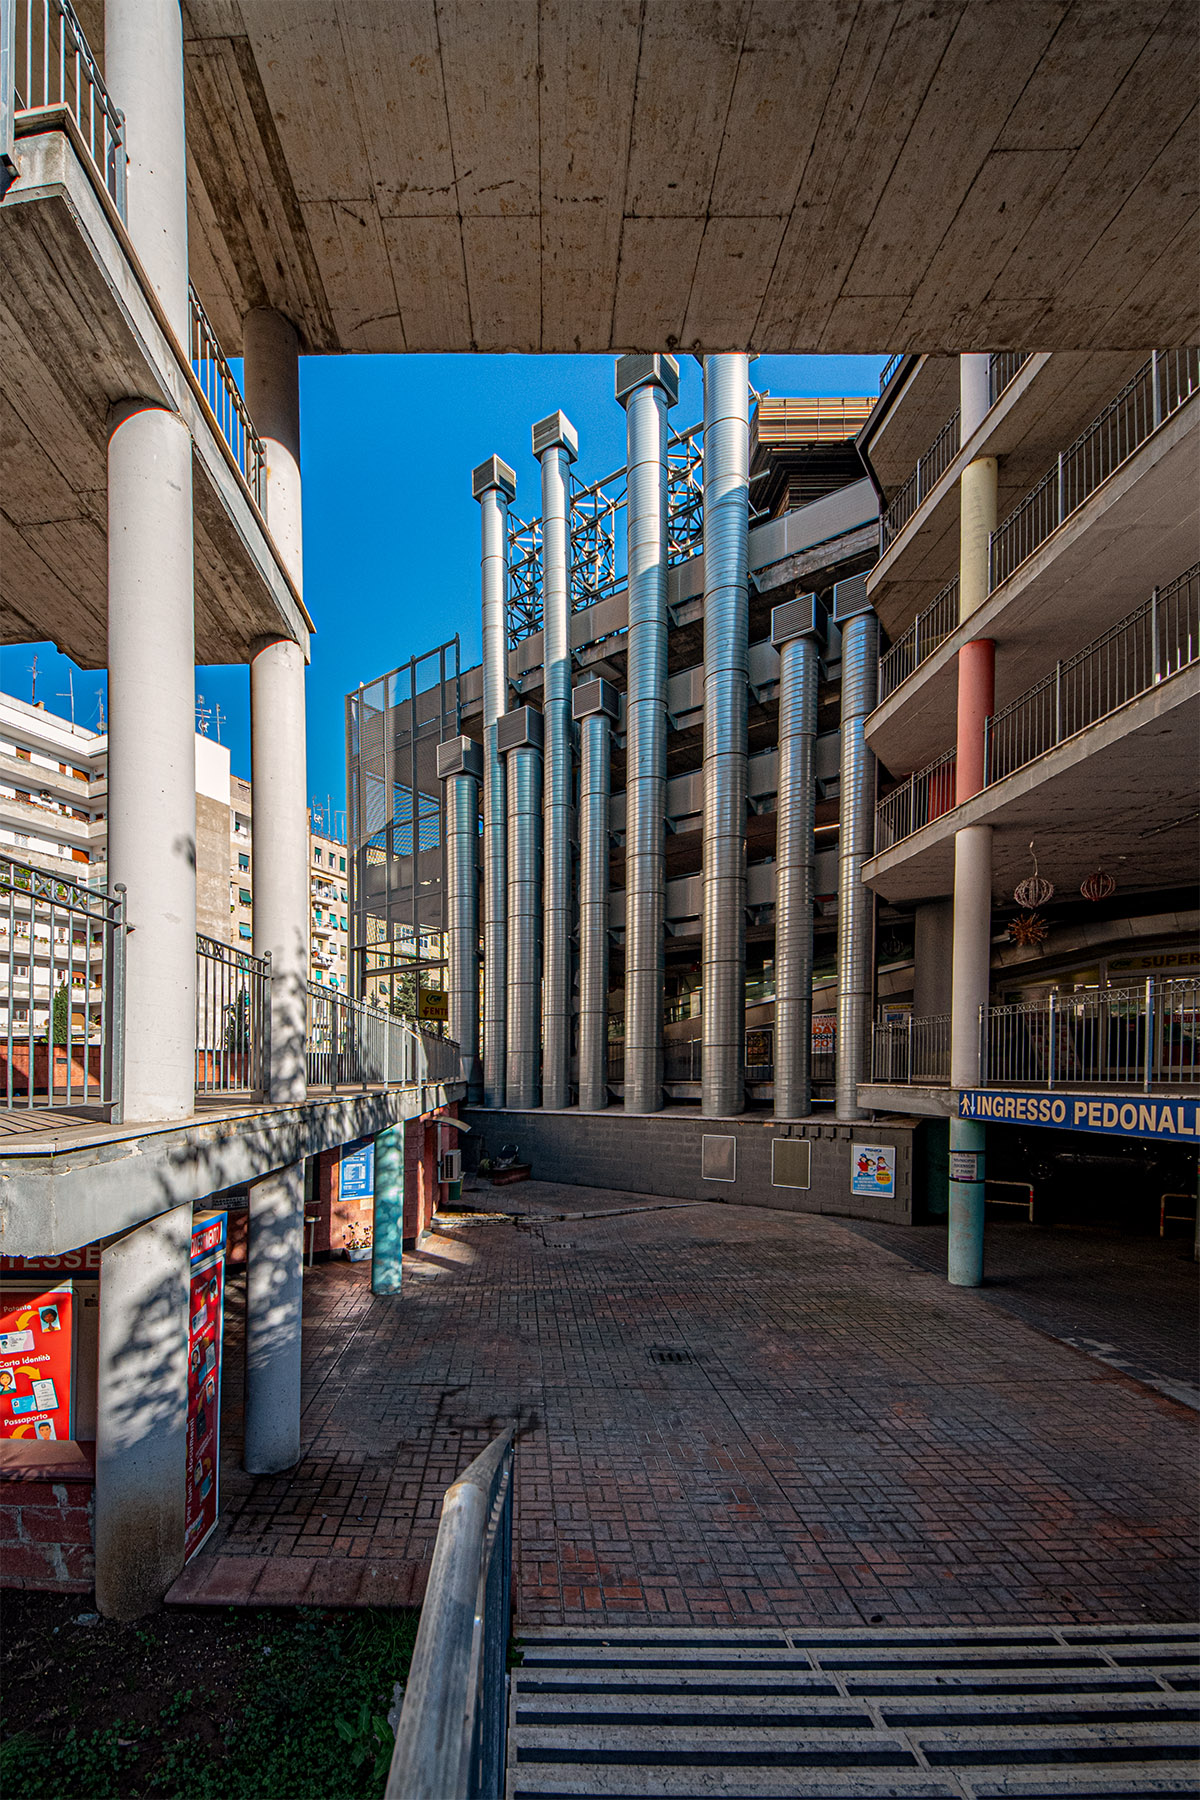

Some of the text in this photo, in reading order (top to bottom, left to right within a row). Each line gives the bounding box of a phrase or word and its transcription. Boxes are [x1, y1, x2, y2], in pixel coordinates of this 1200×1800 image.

[976, 1095, 1066, 1123] INGRESSO
[3, 1304, 32, 1313] Patente
[0, 1352, 51, 1368] Carta Identità
[4, 1413, 48, 1427] Passaporto
